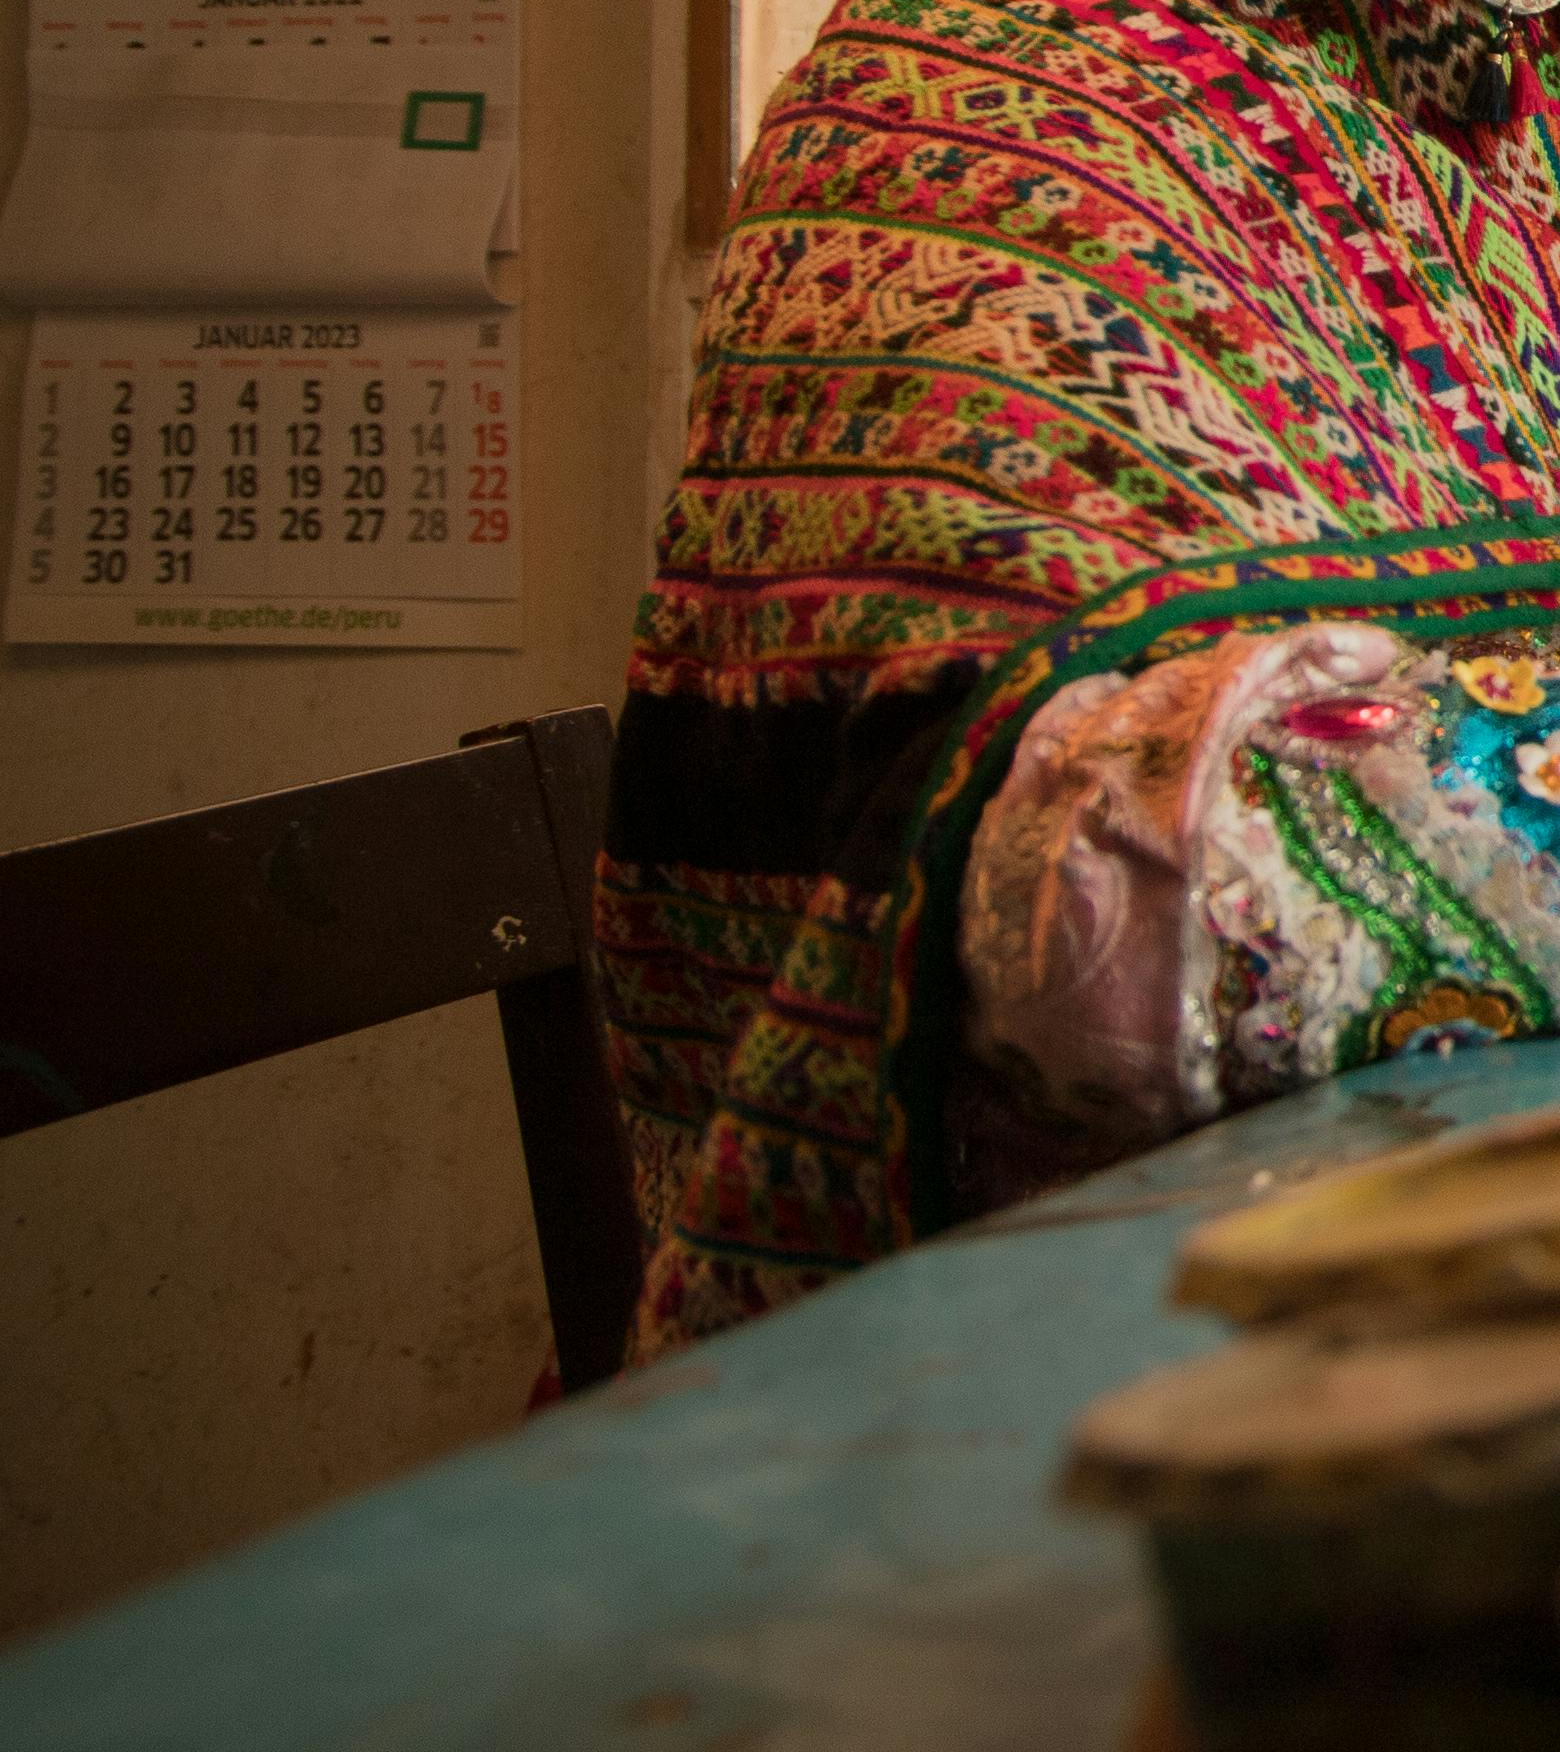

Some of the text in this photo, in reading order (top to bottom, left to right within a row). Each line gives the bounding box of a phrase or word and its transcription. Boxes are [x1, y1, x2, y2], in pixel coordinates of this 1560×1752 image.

[195, 320, 364, 349] JANUAR 2023
[44, 382, 59, 415] 1
[114, 381, 134, 415] 2
[178, 381, 197, 415] 3
[238, 380, 259, 413] 4
[304, 379, 322, 414] 5
[364, 380, 385, 415] 6
[427, 380, 447, 415] 7
[39, 422, 508, 458] 2 9 10 11 12 13 14 15
[38, 464, 508, 501] 3 16 17 18 19 20 21 22
[33, 507, 509, 543] 4 23 24 25 26 27 28 29
[29, 549, 192, 584] 5 30 31
[135, 606, 403, 632] www.goethe.de/peru
